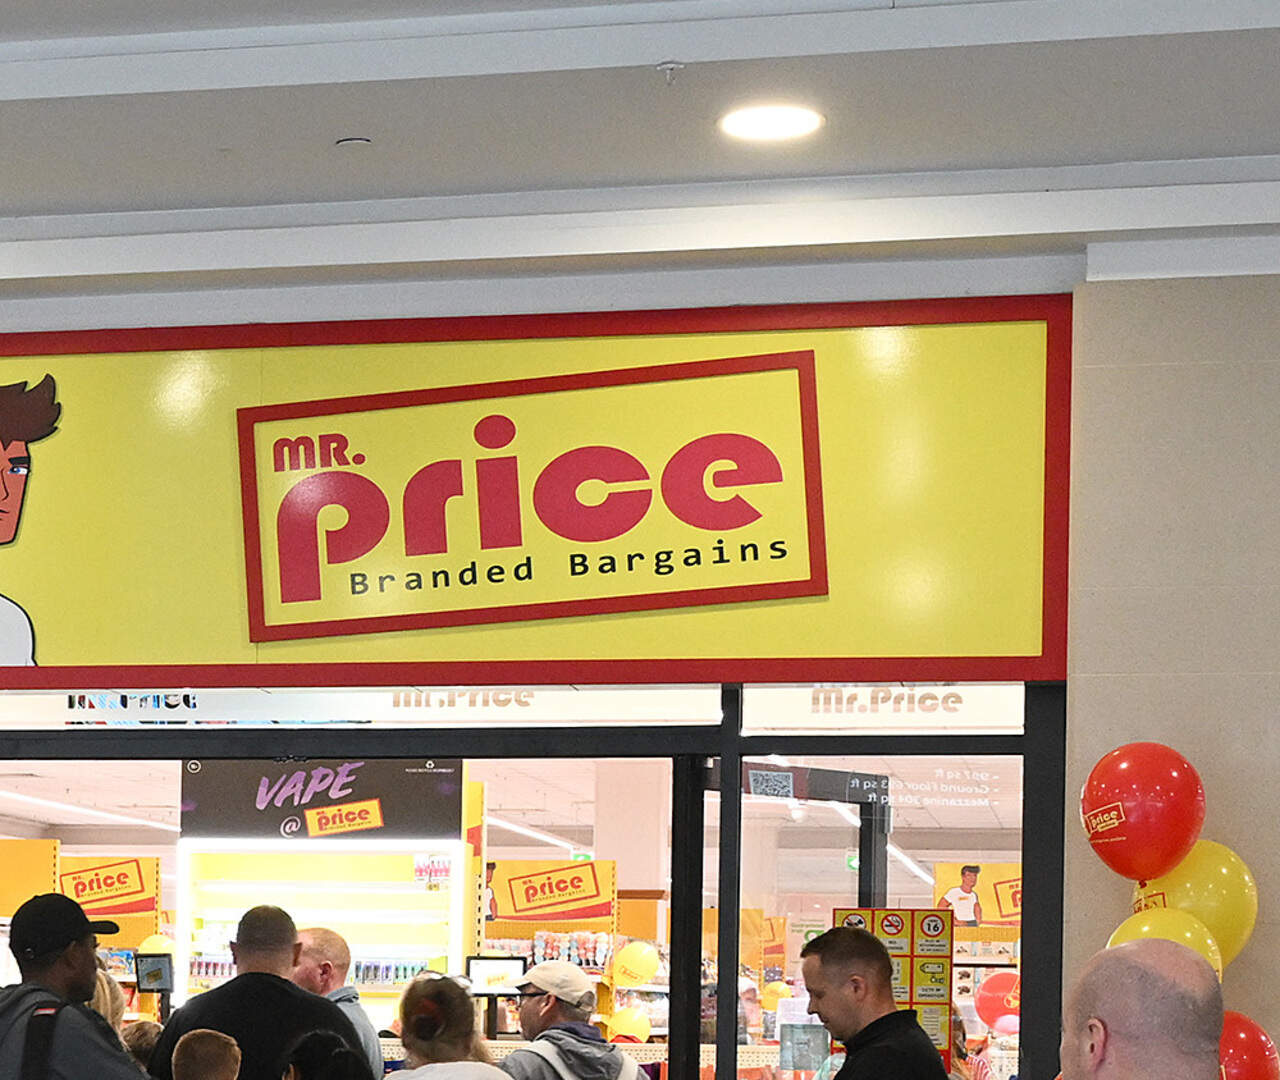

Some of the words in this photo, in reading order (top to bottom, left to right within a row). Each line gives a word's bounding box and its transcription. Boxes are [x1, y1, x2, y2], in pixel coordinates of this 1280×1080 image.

[273, 432, 366, 472] MR.
[277, 413, 783, 604] price
[350, 555, 534, 595] Branded
[569, 537, 789, 577] Bargains
[255, 761, 365, 811] VAPE
[317, 808, 371, 831] price
[74, 872, 129, 898] price
[525, 875, 584, 903] price
